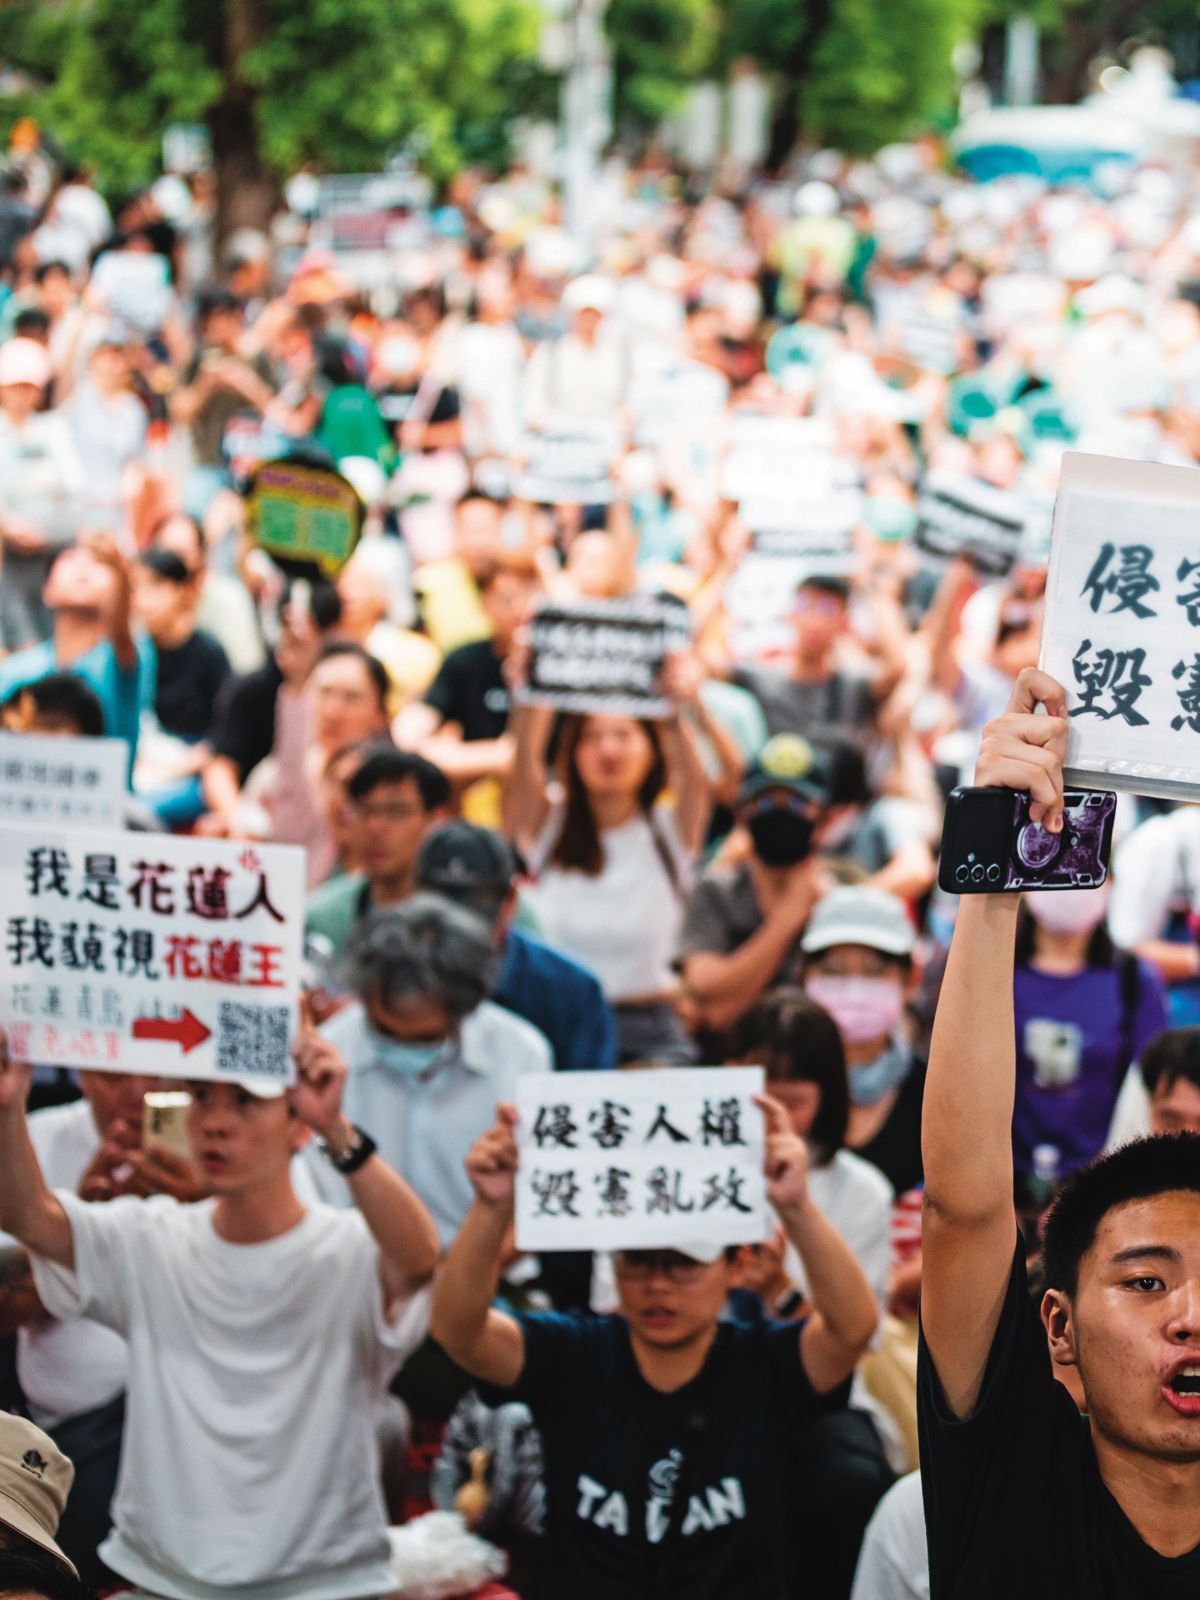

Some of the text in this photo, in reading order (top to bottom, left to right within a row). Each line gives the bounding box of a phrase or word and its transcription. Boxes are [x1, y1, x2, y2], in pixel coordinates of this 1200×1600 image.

[25, 847, 285, 924] 我是花蓮人
[6, 917, 286, 988] 我藐視花蓮王
[532, 1098, 749, 1148] 侵害人權
[530, 1165, 753, 1218] 毀憲亂政
